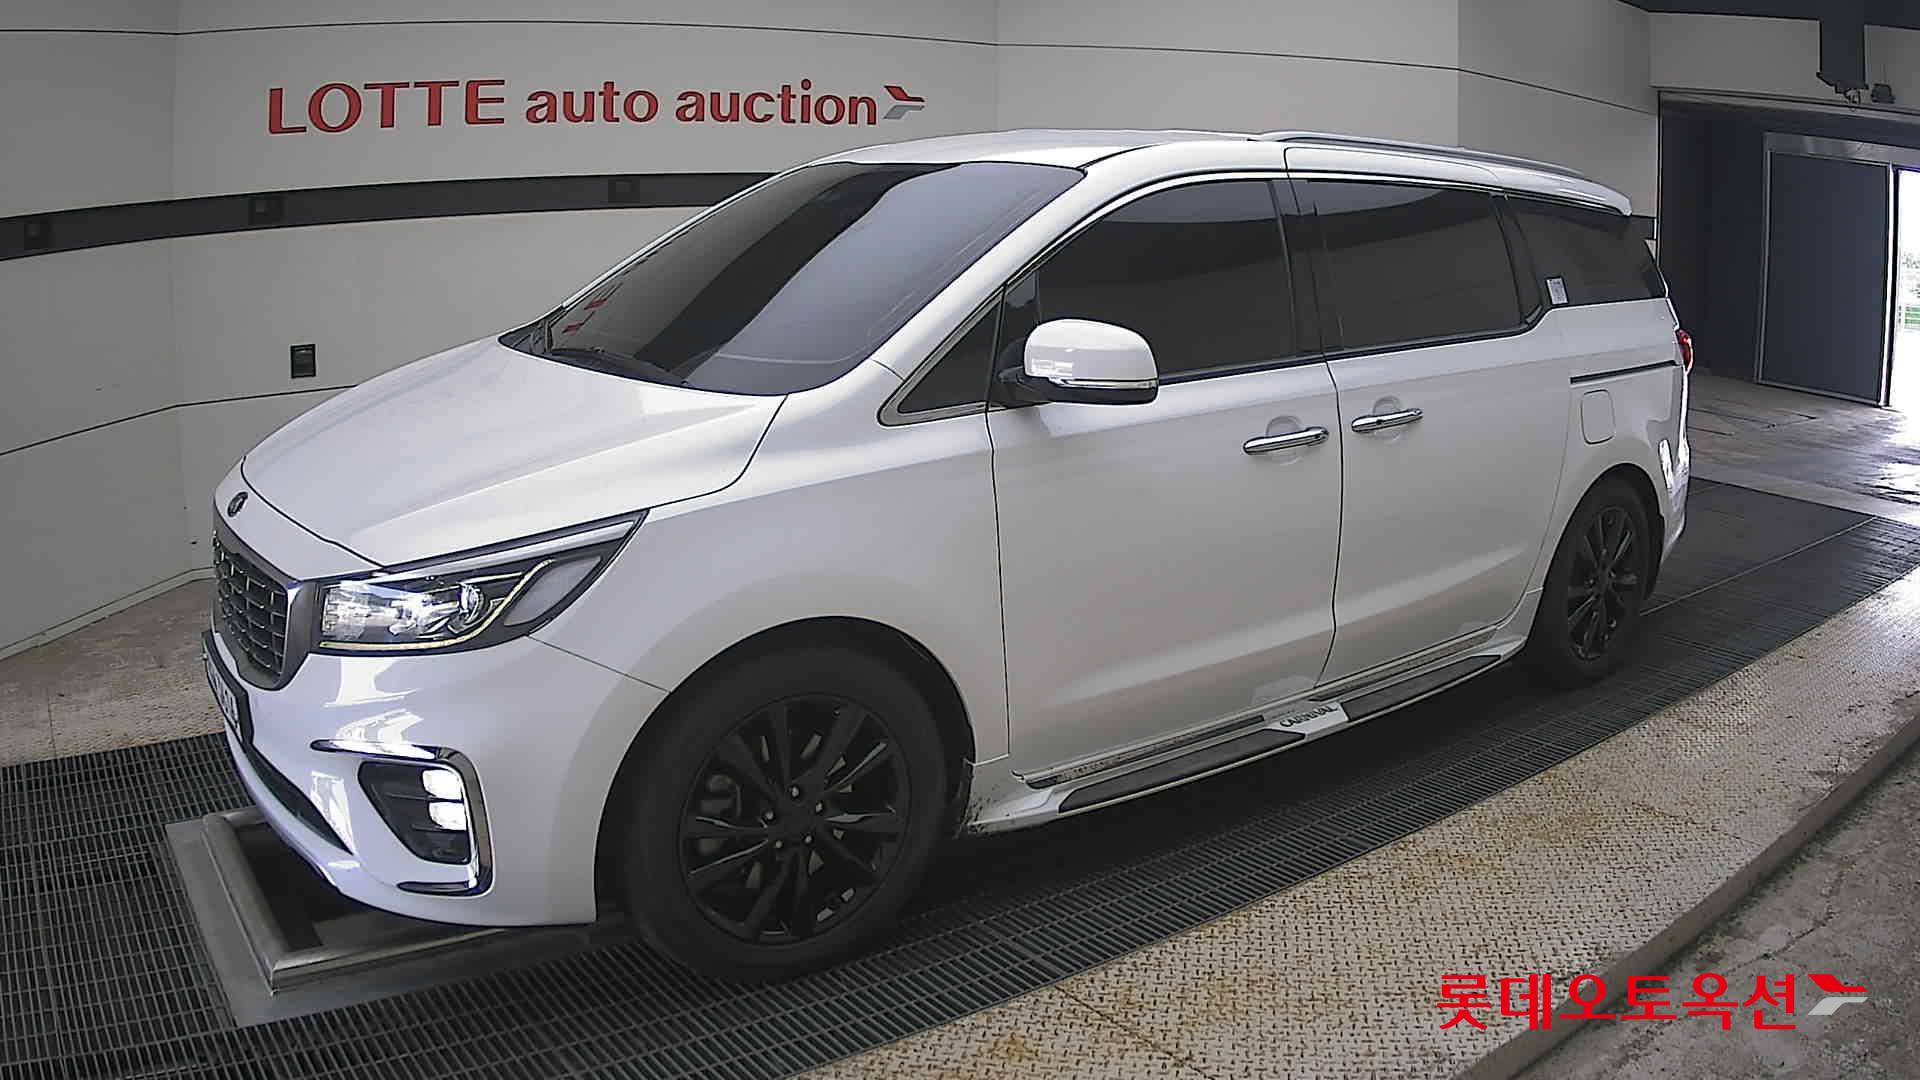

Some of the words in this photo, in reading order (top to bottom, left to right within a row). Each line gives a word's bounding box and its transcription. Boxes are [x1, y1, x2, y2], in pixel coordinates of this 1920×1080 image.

[269, 80, 505, 134] LOTTE
[525, 82, 659, 123] auto
[676, 79, 877, 125] auction
